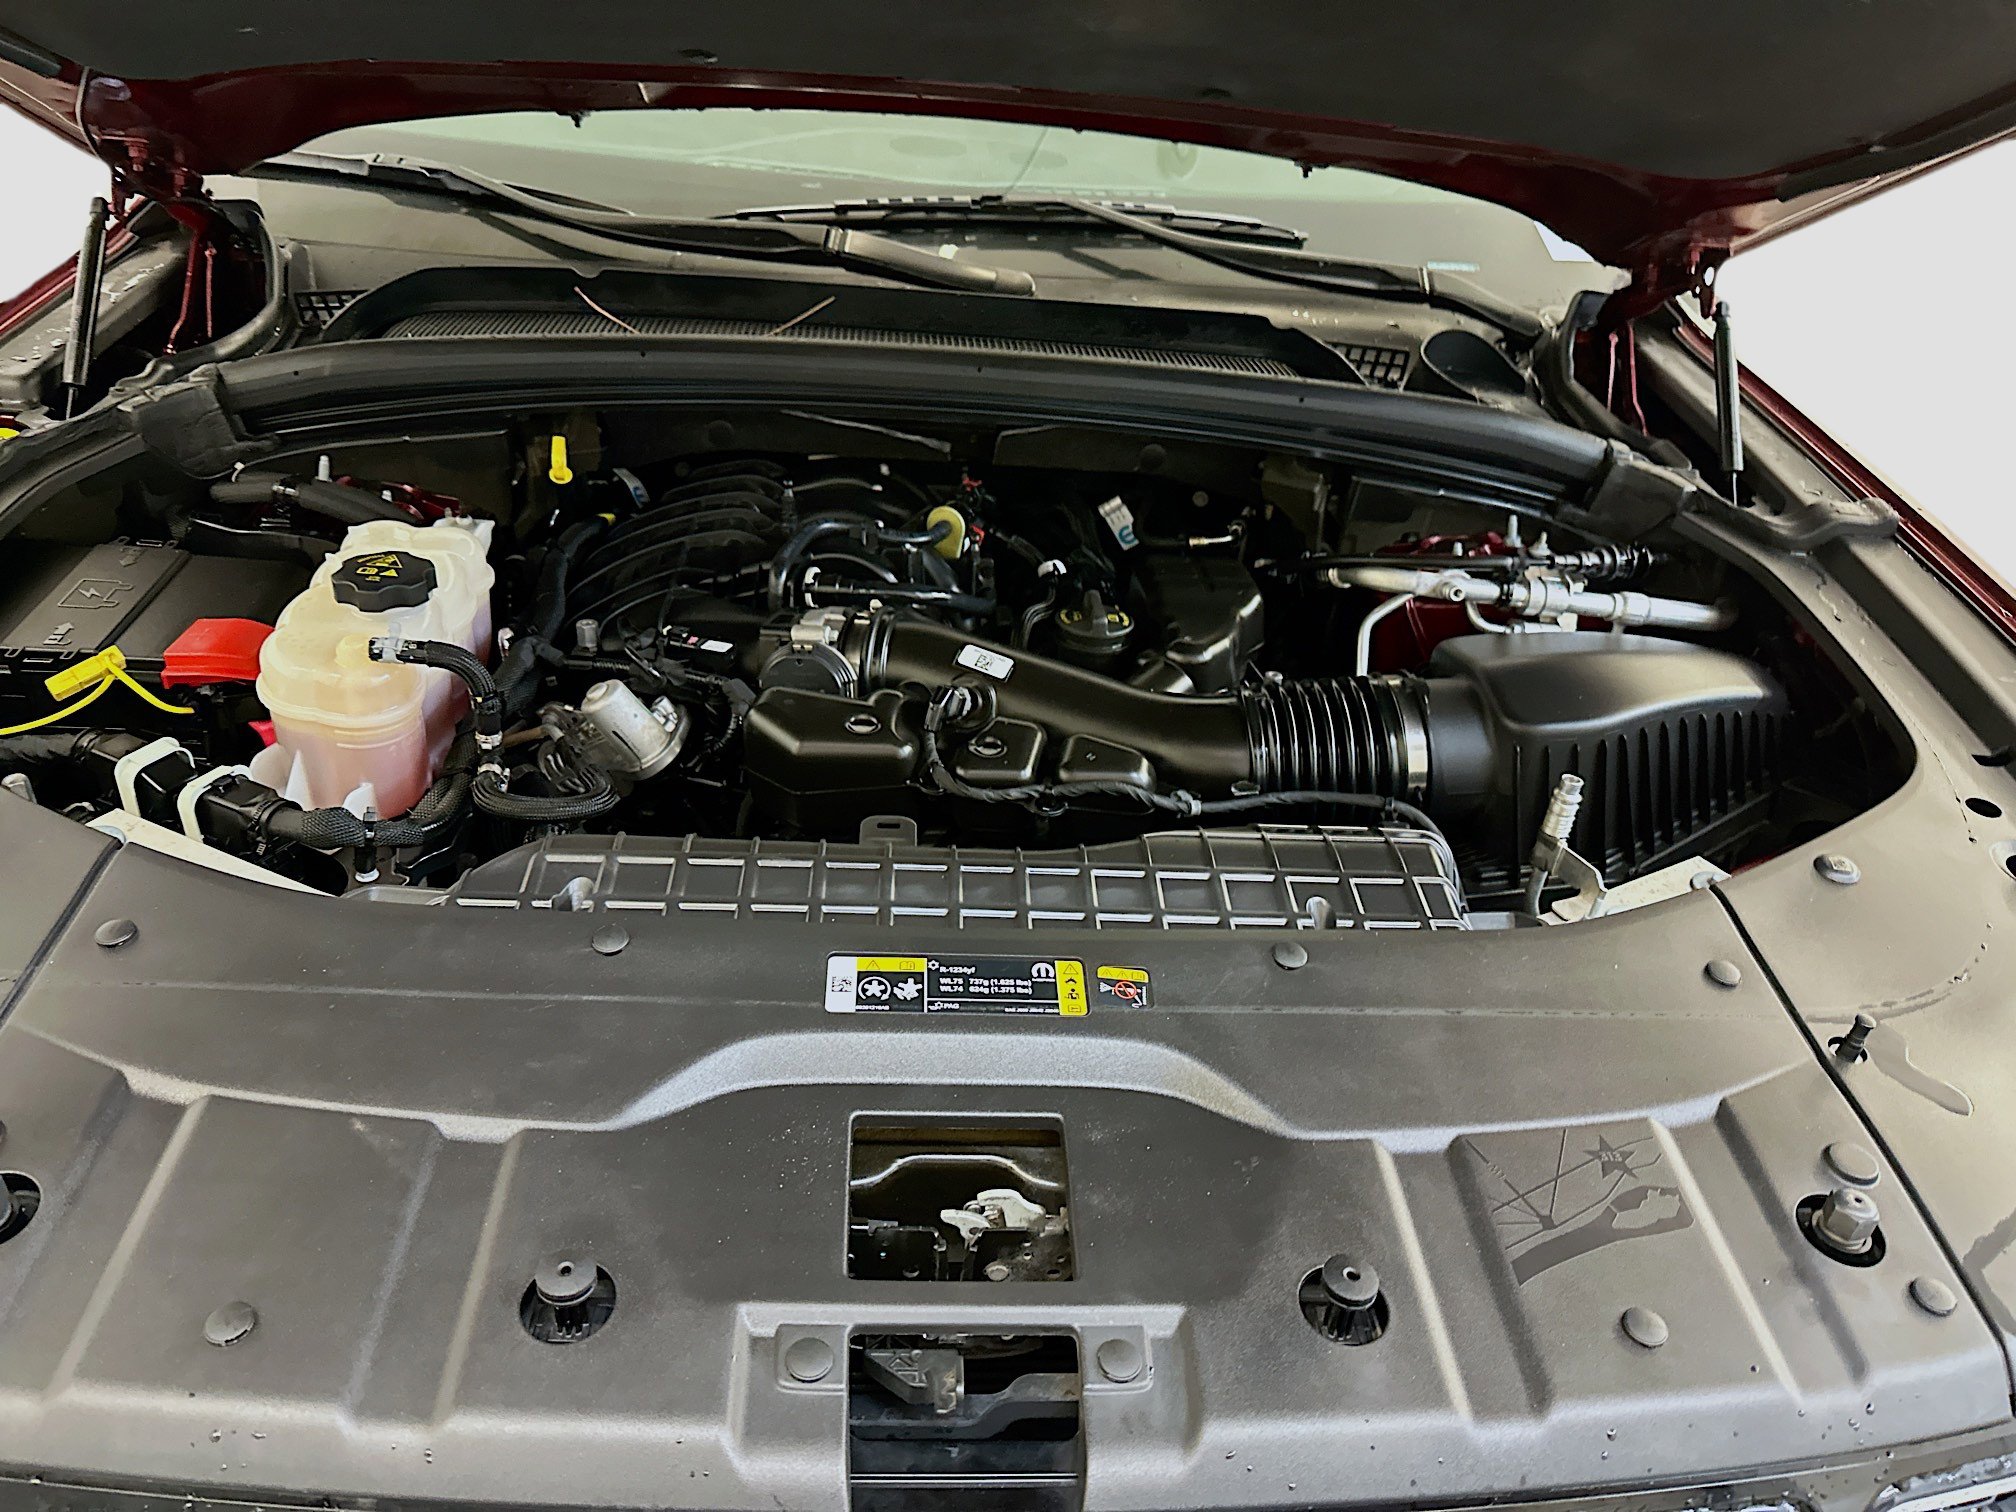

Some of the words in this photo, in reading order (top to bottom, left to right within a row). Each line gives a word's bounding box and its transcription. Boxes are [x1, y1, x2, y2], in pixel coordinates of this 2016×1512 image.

[939, 966, 976, 975] R-1234yf
[939, 977, 964, 985] WL75
[968, 977, 990, 987] 737g
[1015, 979, 1032, 987] lbs)
[939, 985, 964, 993] WL74
[1016, 986, 1033, 995] lbs)
